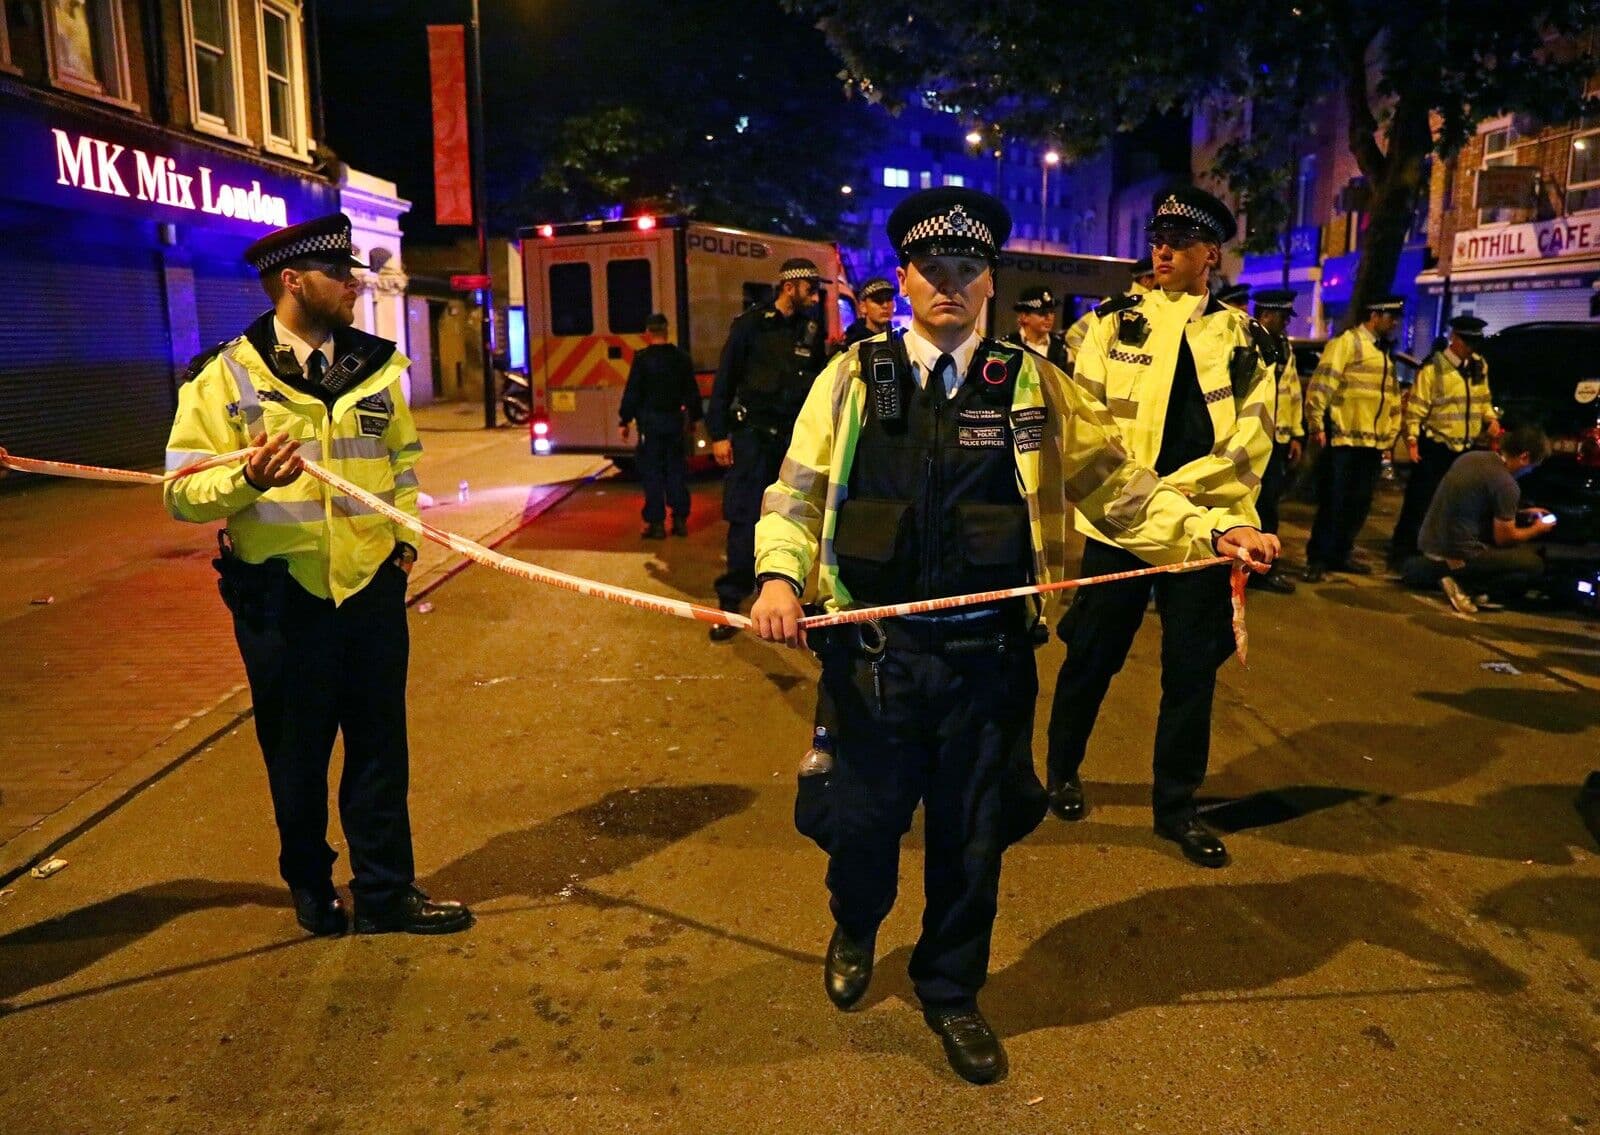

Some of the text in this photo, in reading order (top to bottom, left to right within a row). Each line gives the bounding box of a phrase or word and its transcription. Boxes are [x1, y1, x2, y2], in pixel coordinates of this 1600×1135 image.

[52, 129, 288, 227] MK Mix London
[688, 235, 764, 259] POLICE
[1537, 223, 1592, 252] CAFE
